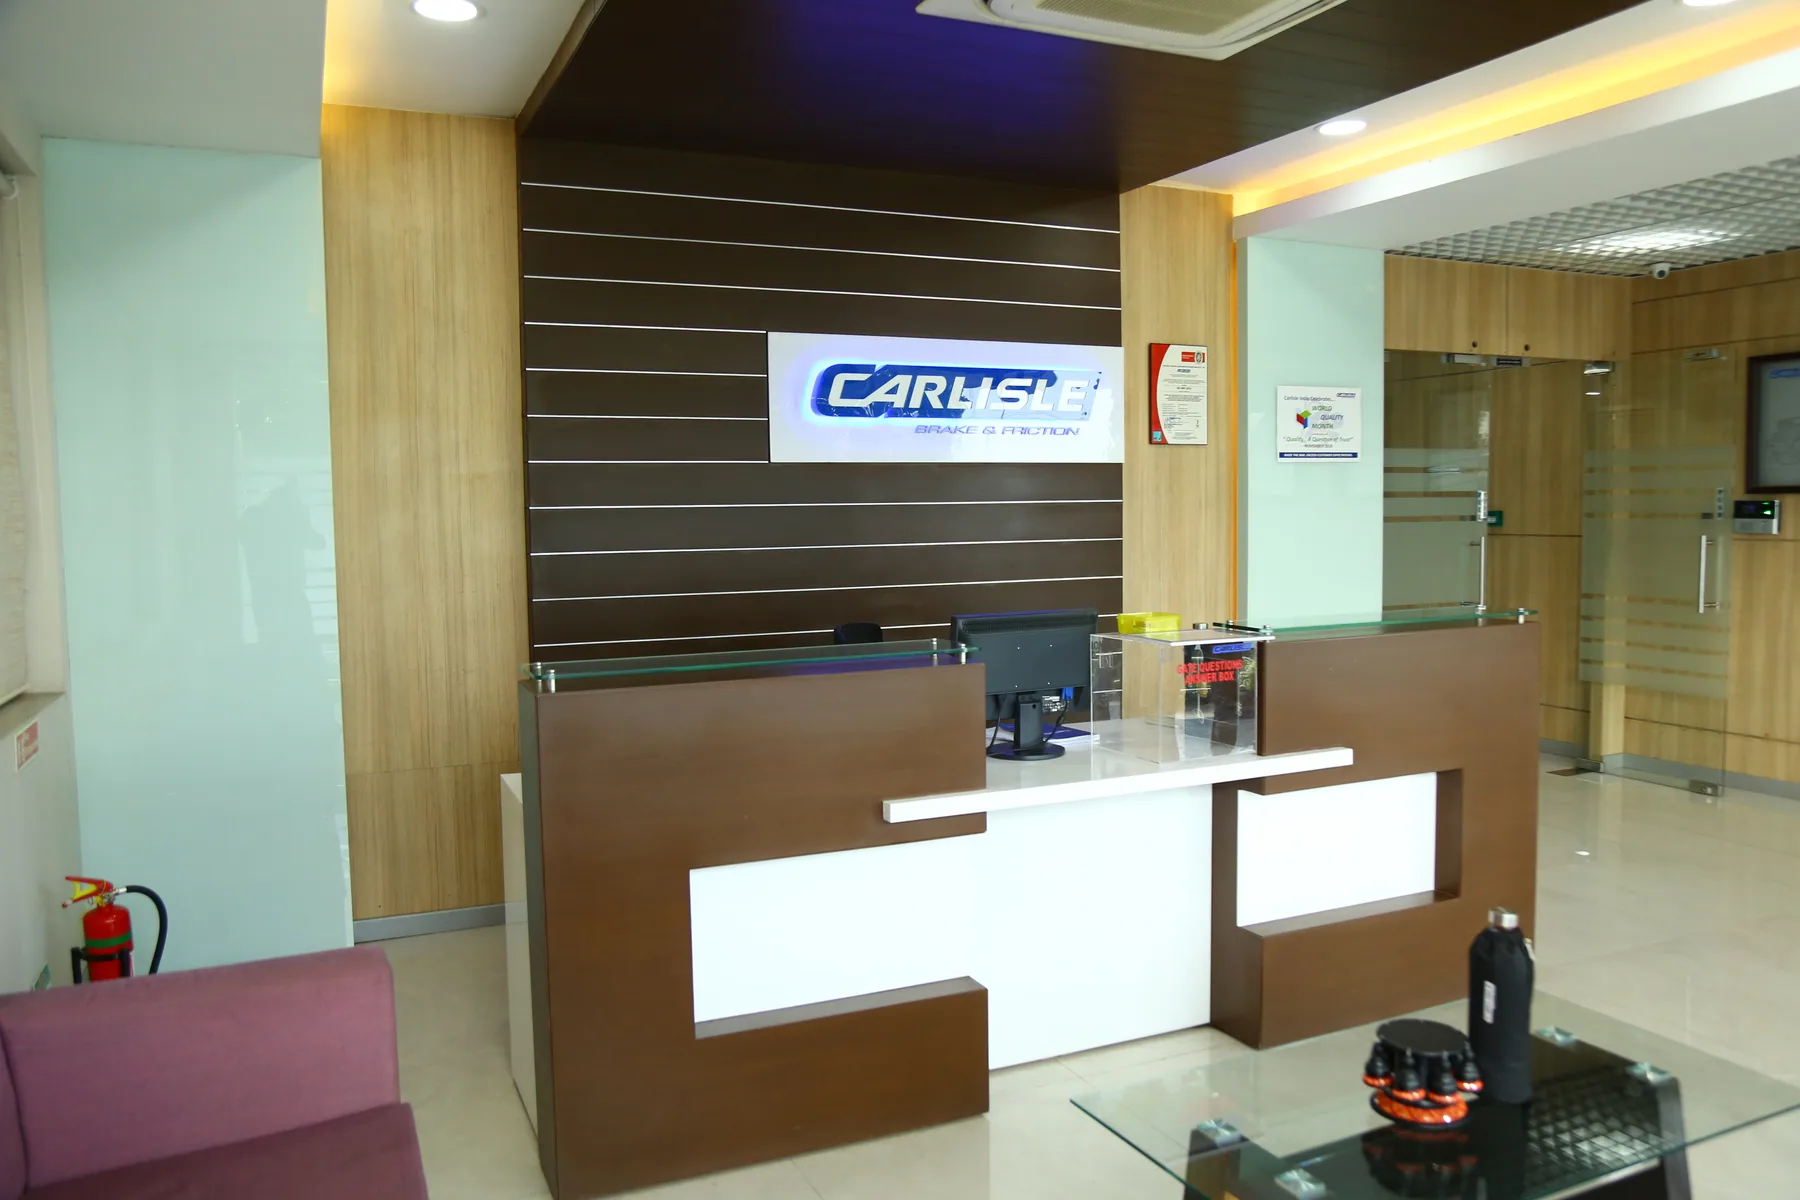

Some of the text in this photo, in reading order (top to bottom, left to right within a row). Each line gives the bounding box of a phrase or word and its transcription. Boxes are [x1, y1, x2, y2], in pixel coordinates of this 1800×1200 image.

[828, 373, 1092, 412] CARLISLE
[914, 425, 1080, 437] BRAKE & FRICTION
[1178, 660, 1243, 674] GATE QUESTIONS
[1185, 671, 1234, 684] ANSWER BOX
